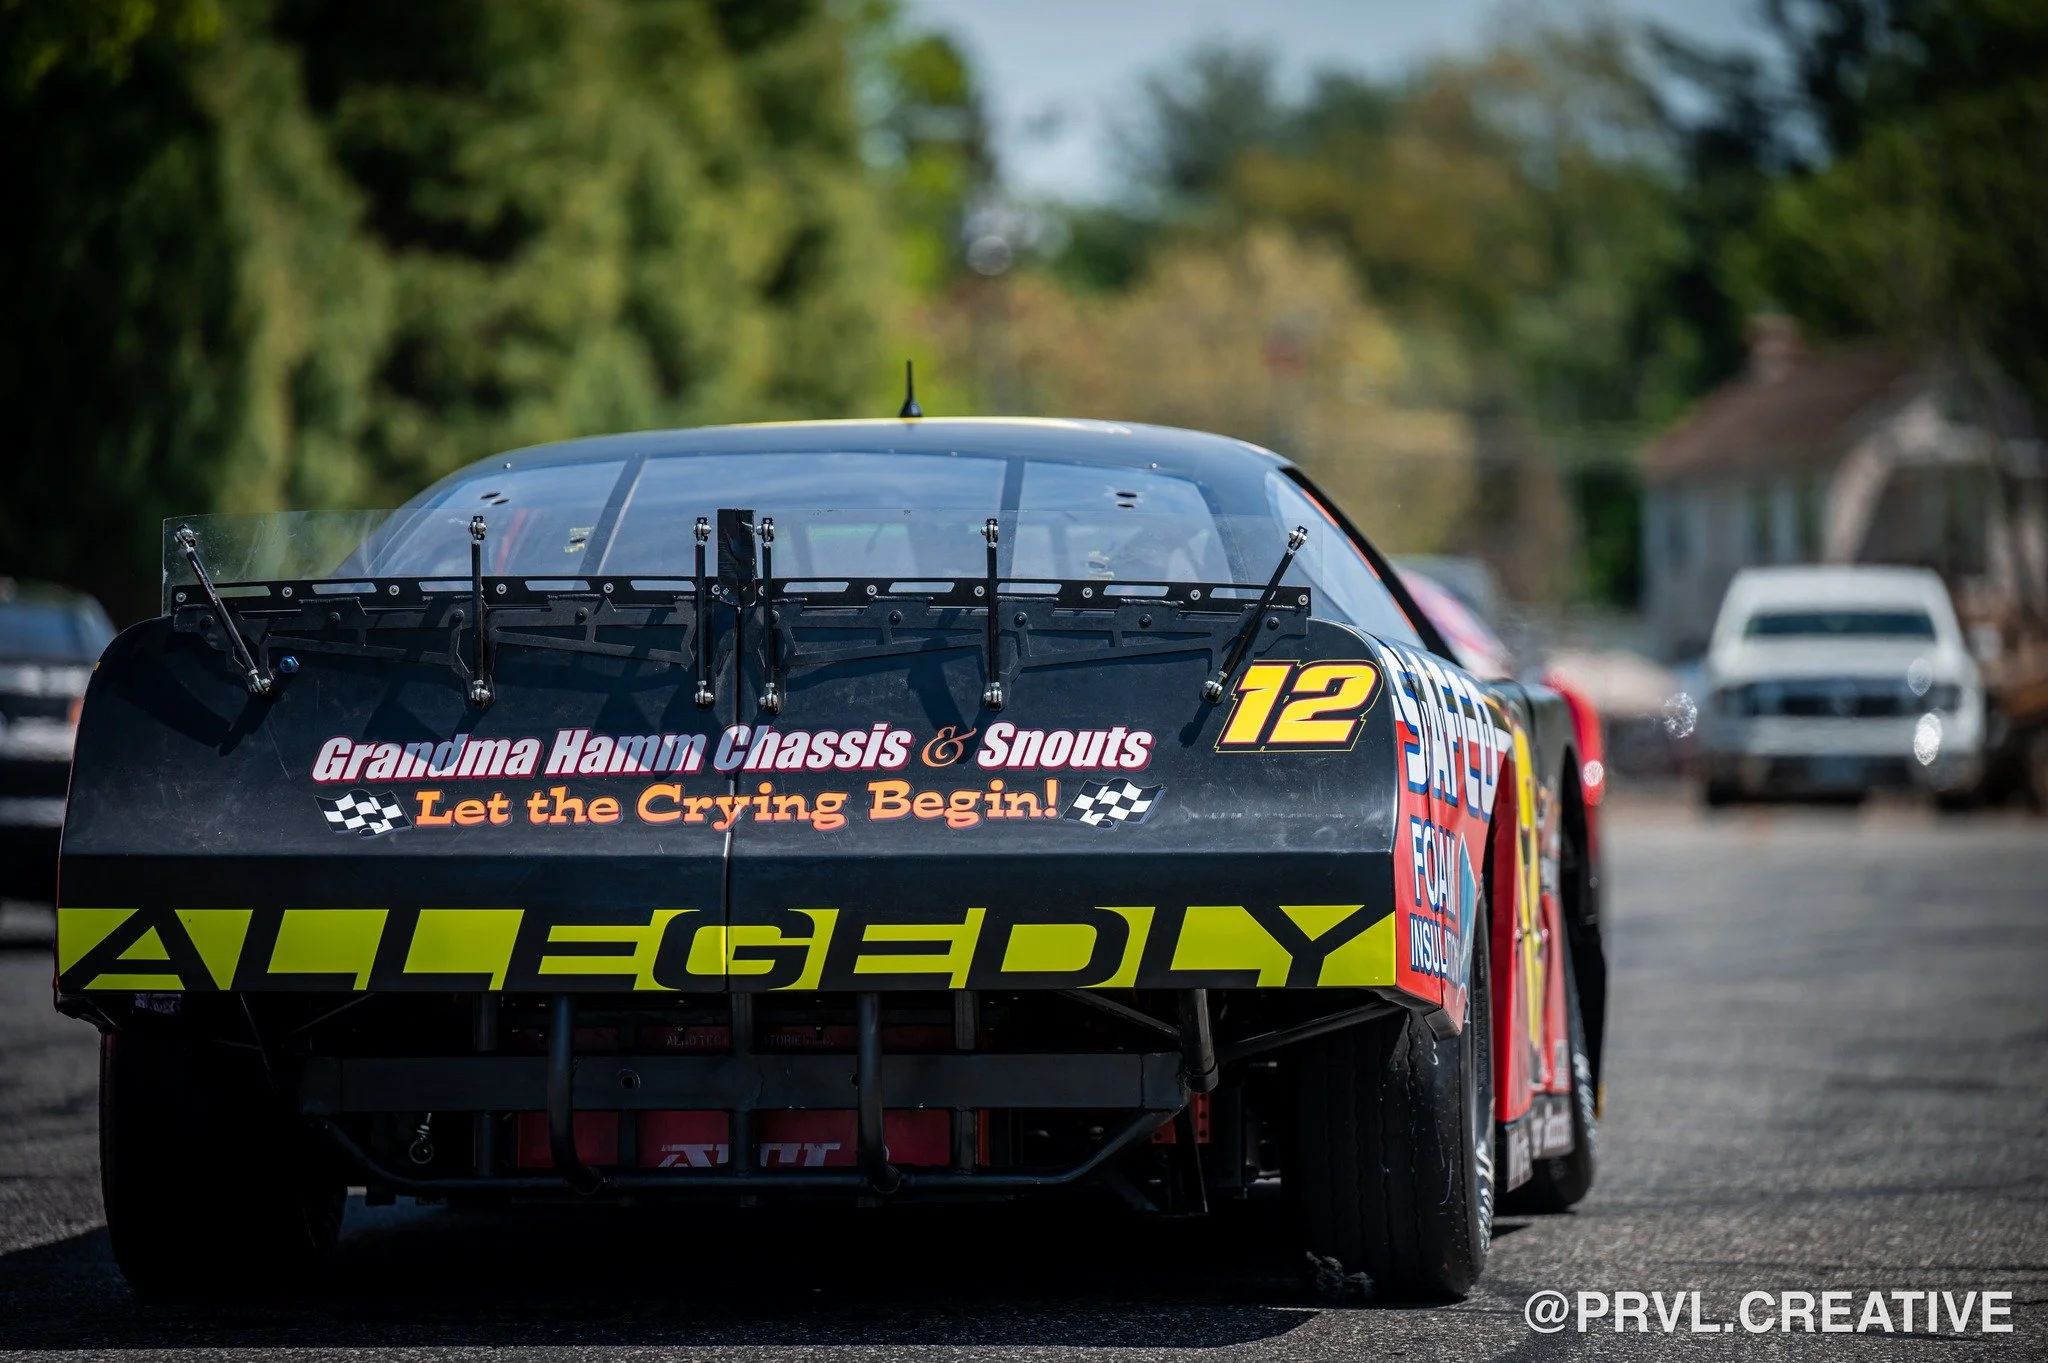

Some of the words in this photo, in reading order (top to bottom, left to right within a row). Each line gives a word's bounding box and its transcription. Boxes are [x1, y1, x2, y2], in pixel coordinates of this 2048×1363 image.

[1218, 661, 1380, 746] 12
[311, 734, 544, 783] Grandma
[544, 728, 707, 777] Hamm
[713, 722, 914, 774] Chassis
[921, 725, 976, 768] &
[977, 721, 1156, 773] Snouts
[414, 788, 512, 827] Let
[527, 784, 621, 826] the
[636, 781, 849, 832] Crying
[866, 778, 1060, 830] Begin!
[59, 906, 1396, 990] ALLEGEDLY
